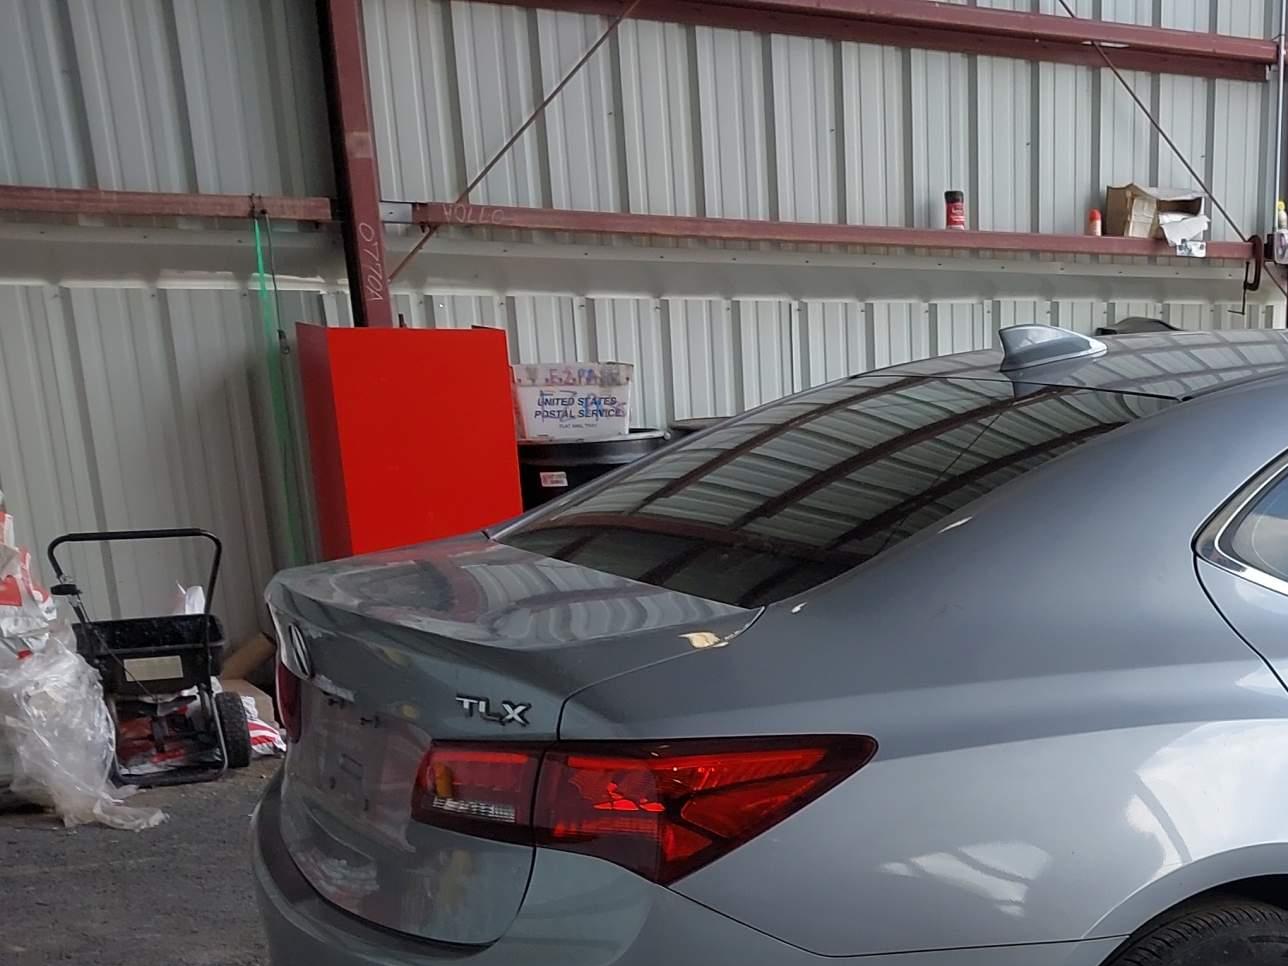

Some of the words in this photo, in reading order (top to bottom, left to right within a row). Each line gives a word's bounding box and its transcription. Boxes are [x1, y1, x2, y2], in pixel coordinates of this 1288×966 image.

[537, 397, 575, 407] UNITED
[577, 396, 617, 406] STATES
[534, 409, 576, 419] POSTAL
[578, 408, 625, 418] SERVICE
[455, 694, 531, 727] TLX
